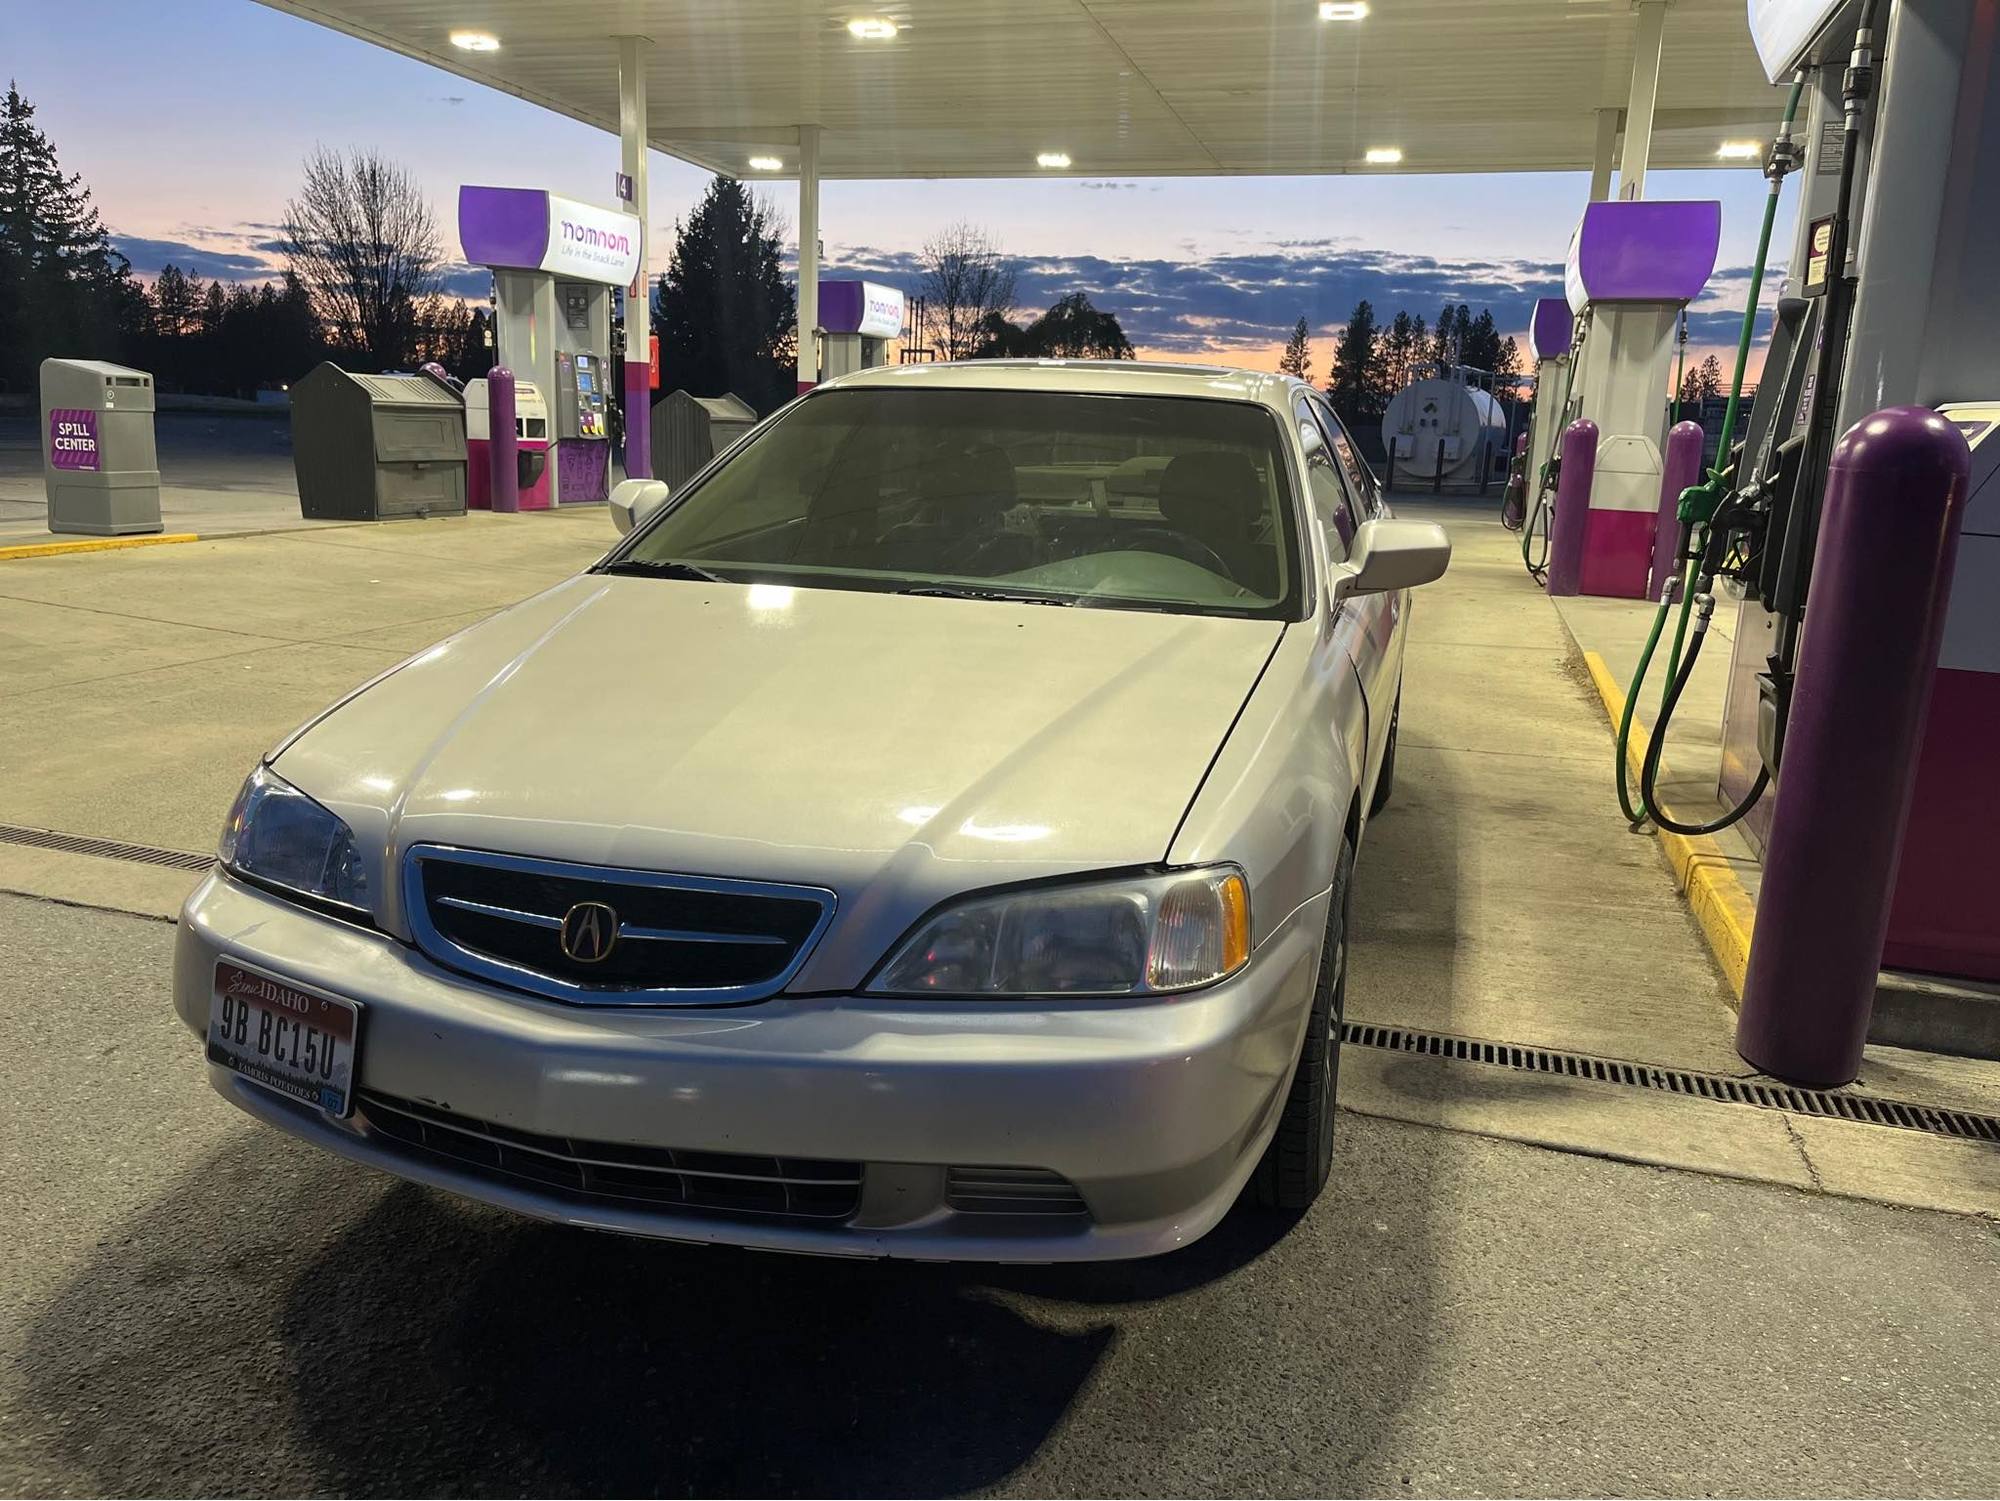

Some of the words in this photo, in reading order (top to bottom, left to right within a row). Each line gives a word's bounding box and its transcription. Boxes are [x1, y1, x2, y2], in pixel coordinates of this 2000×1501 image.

[620, 178, 627, 196] 4
[561, 220, 630, 256] nomnom
[55, 437, 96, 452] CENTER
[58, 422, 90, 436] SPILL
[257, 981, 310, 1014] IDAHO
[220, 995, 249, 1046] 9B
[258, 1009, 336, 1080] BC15U
[238, 1062, 269, 1082] FAMOUS
[270, 1075, 311, 1100] POTATOES
